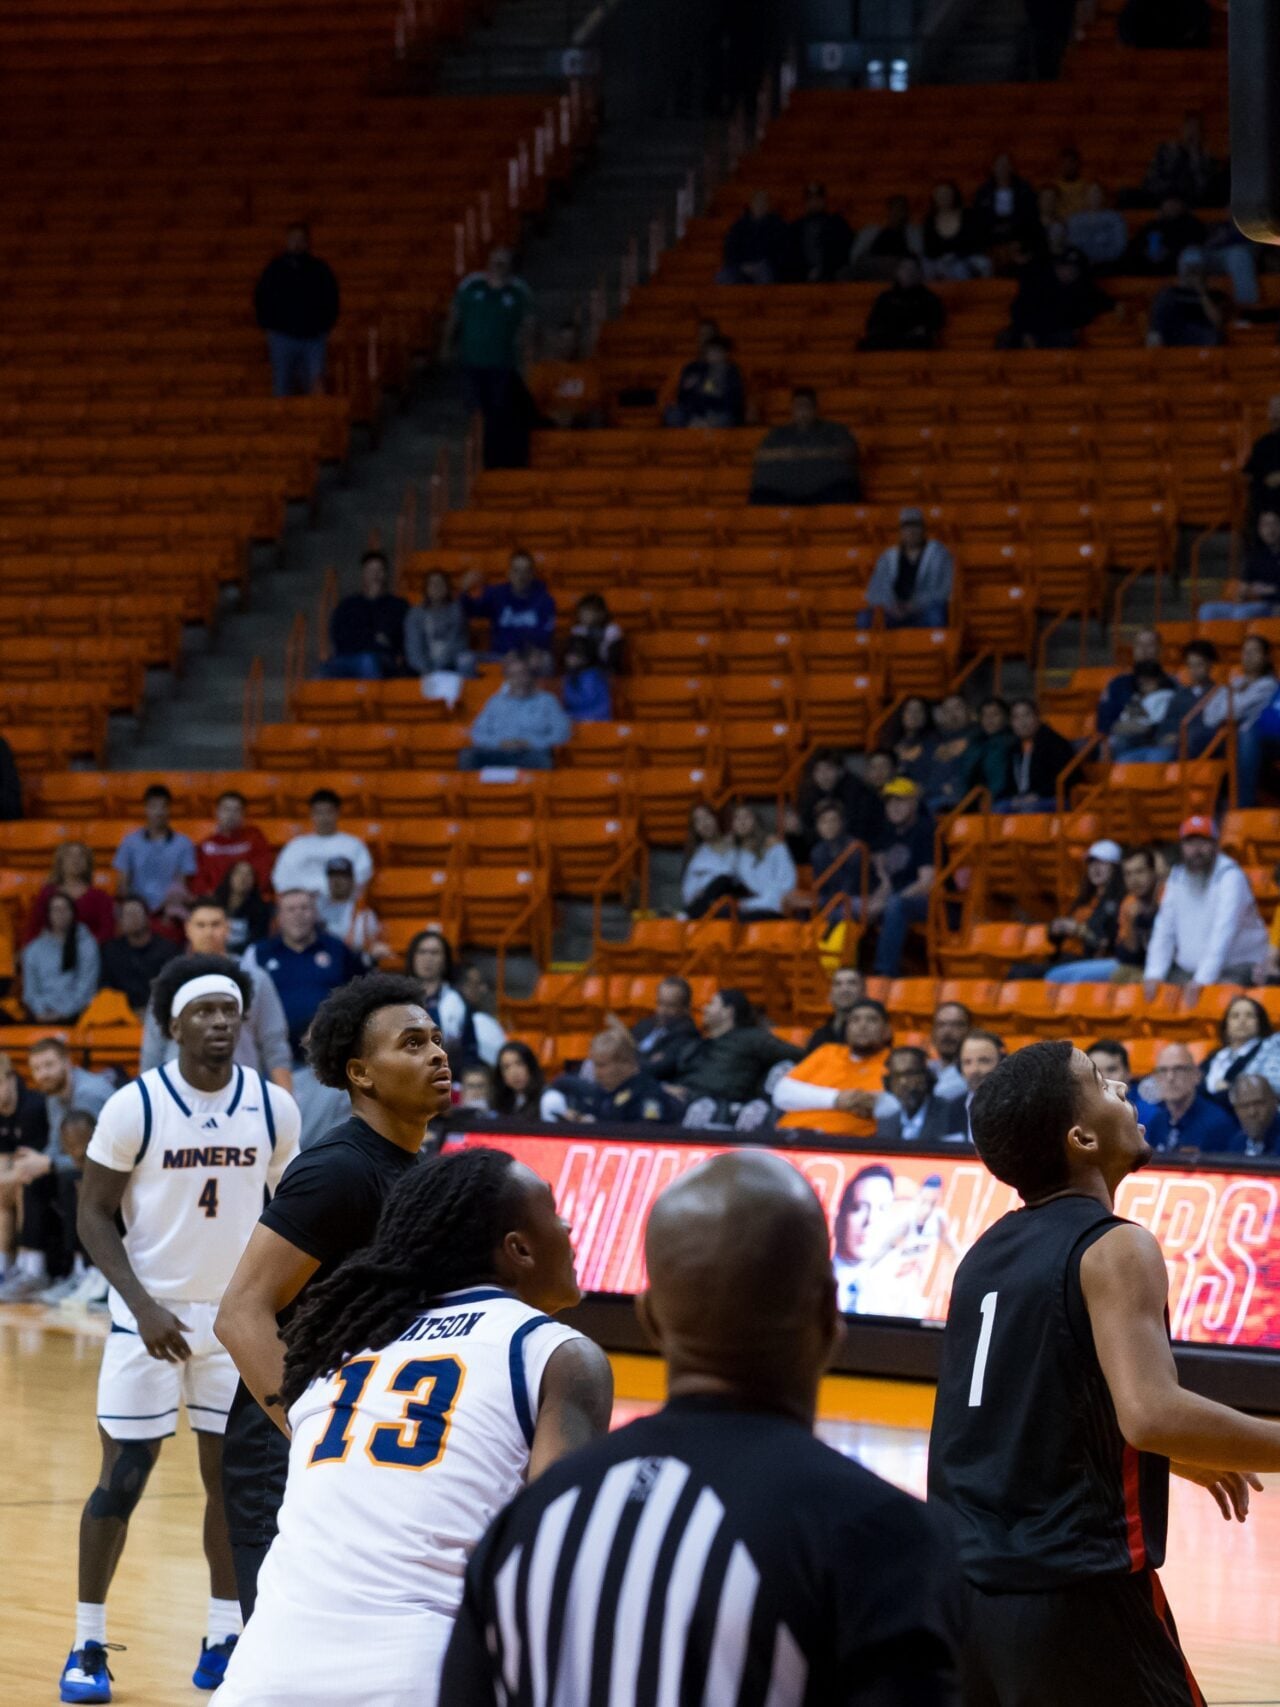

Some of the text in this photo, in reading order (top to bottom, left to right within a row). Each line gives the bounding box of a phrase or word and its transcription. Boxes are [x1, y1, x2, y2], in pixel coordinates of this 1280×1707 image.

[162, 1146, 258, 1170] MINERS
[198, 1177, 219, 1219] 4
[398, 1311, 487, 1342] ATSON
[968, 1291, 999, 1407] 1
[306, 1353, 468, 1473] 13
